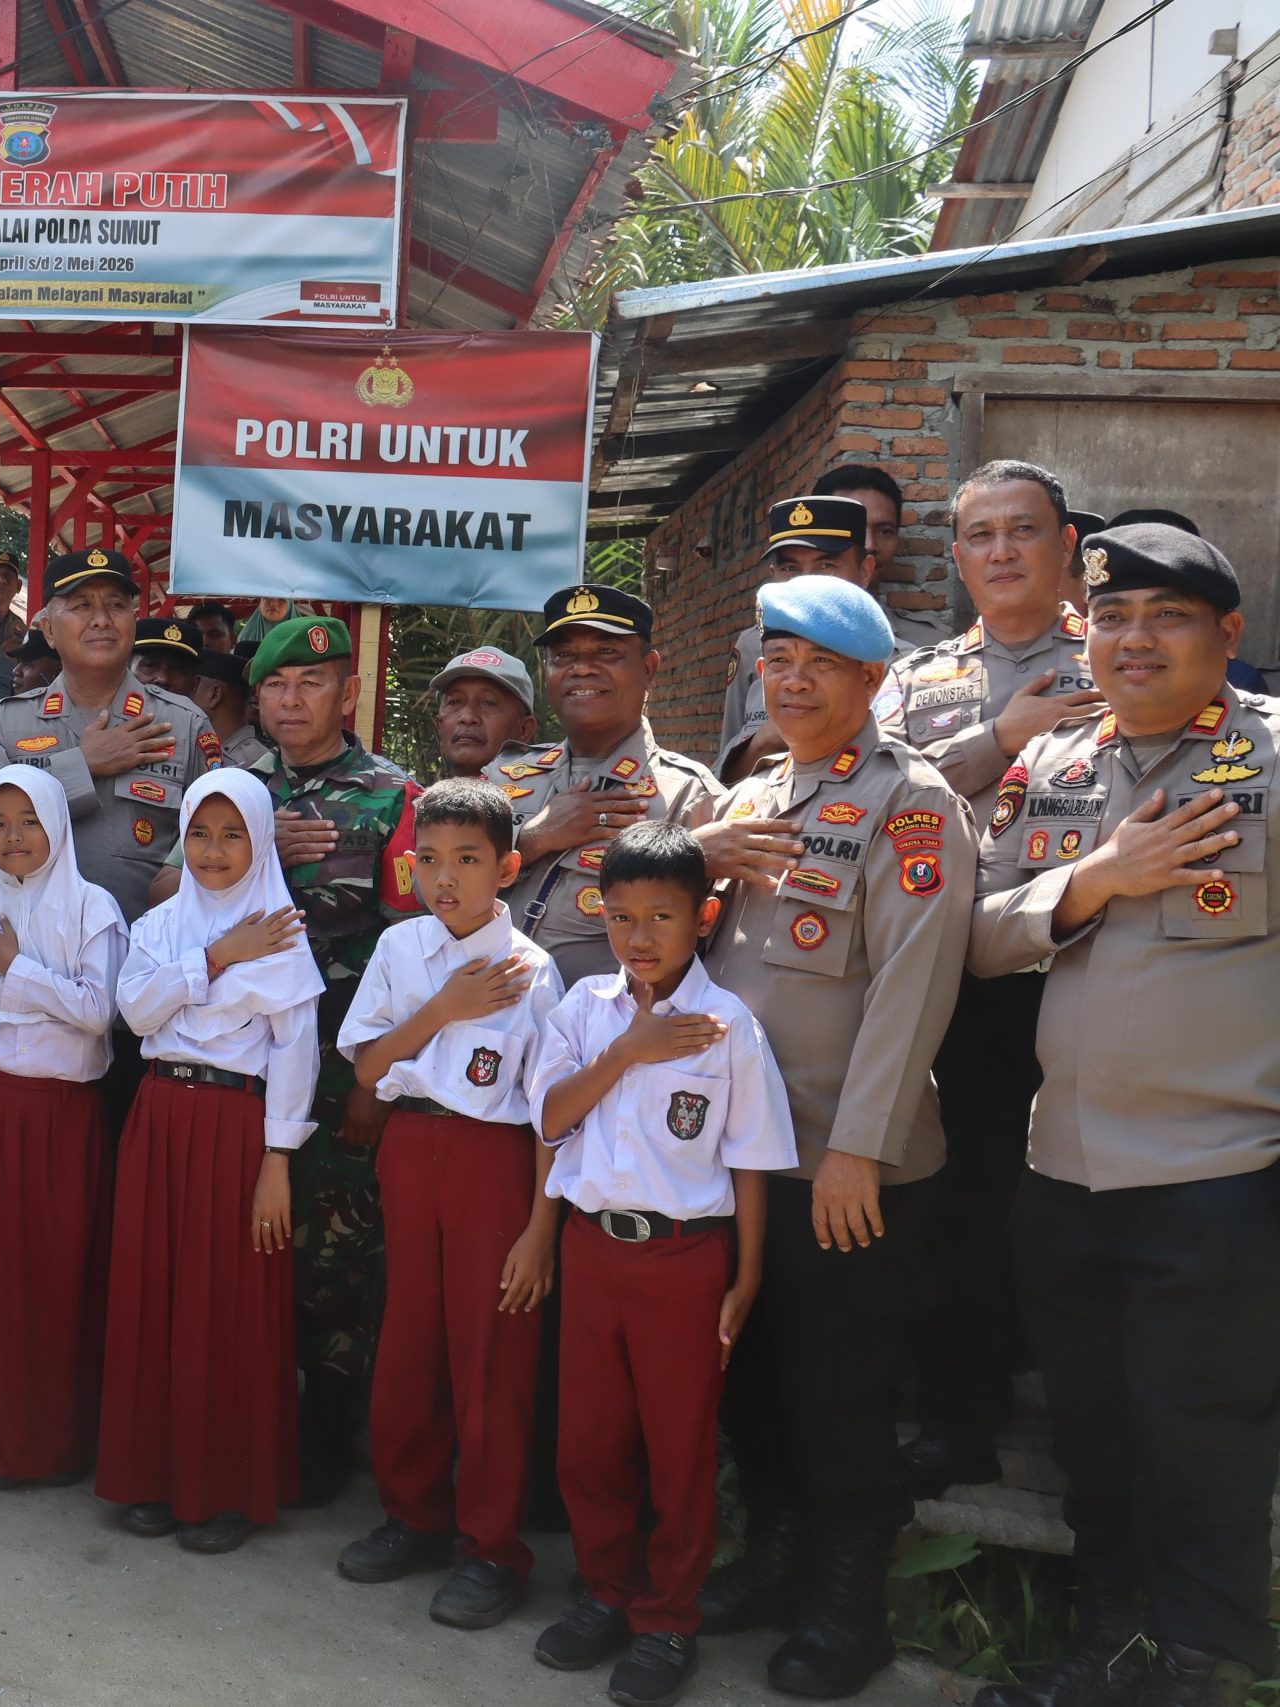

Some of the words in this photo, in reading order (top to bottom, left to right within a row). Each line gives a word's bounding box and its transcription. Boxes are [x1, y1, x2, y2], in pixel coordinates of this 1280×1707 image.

[113, 172, 228, 209] PUTIH
[34, 217, 93, 245] POLDA
[97, 219, 161, 246] SUMUT
[28, 256, 50, 271] s/d
[53, 256, 63, 271] 2
[67, 256, 95, 272] Mei
[98, 257, 135, 272] 2026
[37, 287, 104, 304] Melayani
[108, 288, 193, 305] Masyarakat
[235, 418, 363, 461] POLRI
[379, 424, 529, 468] UNTUK
[223, 500, 532, 552] MASYARAKAT
[915, 685, 975, 708] DEMONSTAR
[137, 763, 177, 777] OLRI
[888, 814, 939, 832] POLRES
[893, 824, 919, 835] TANJUNG
[801, 835, 862, 861] POLRI
